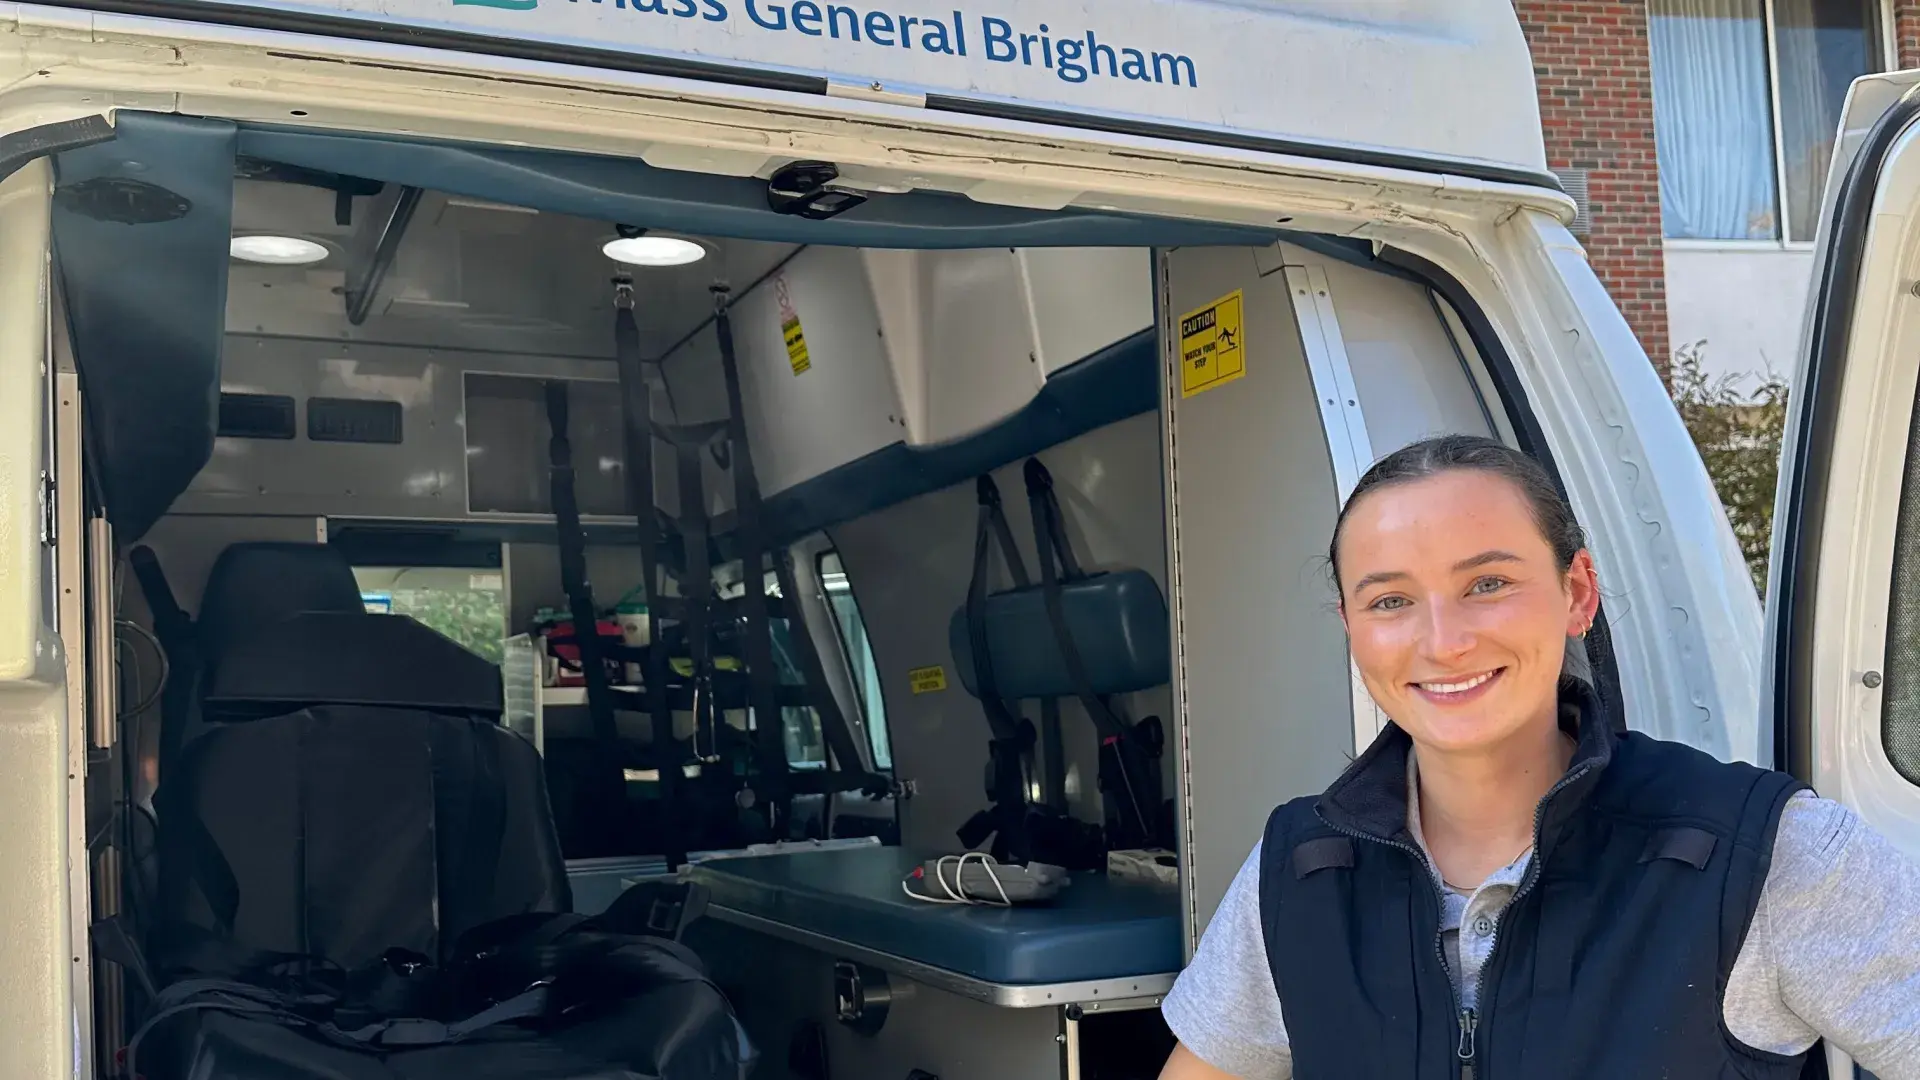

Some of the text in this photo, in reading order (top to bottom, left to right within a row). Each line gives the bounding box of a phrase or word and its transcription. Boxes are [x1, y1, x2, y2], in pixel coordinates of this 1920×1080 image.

[569, 0, 1197, 88] ss General Brigham
[1183, 310, 1215, 336] CAUTION
[1185, 341, 1216, 362] WATCH YOUR
[1195, 357, 1207, 370] STEP
